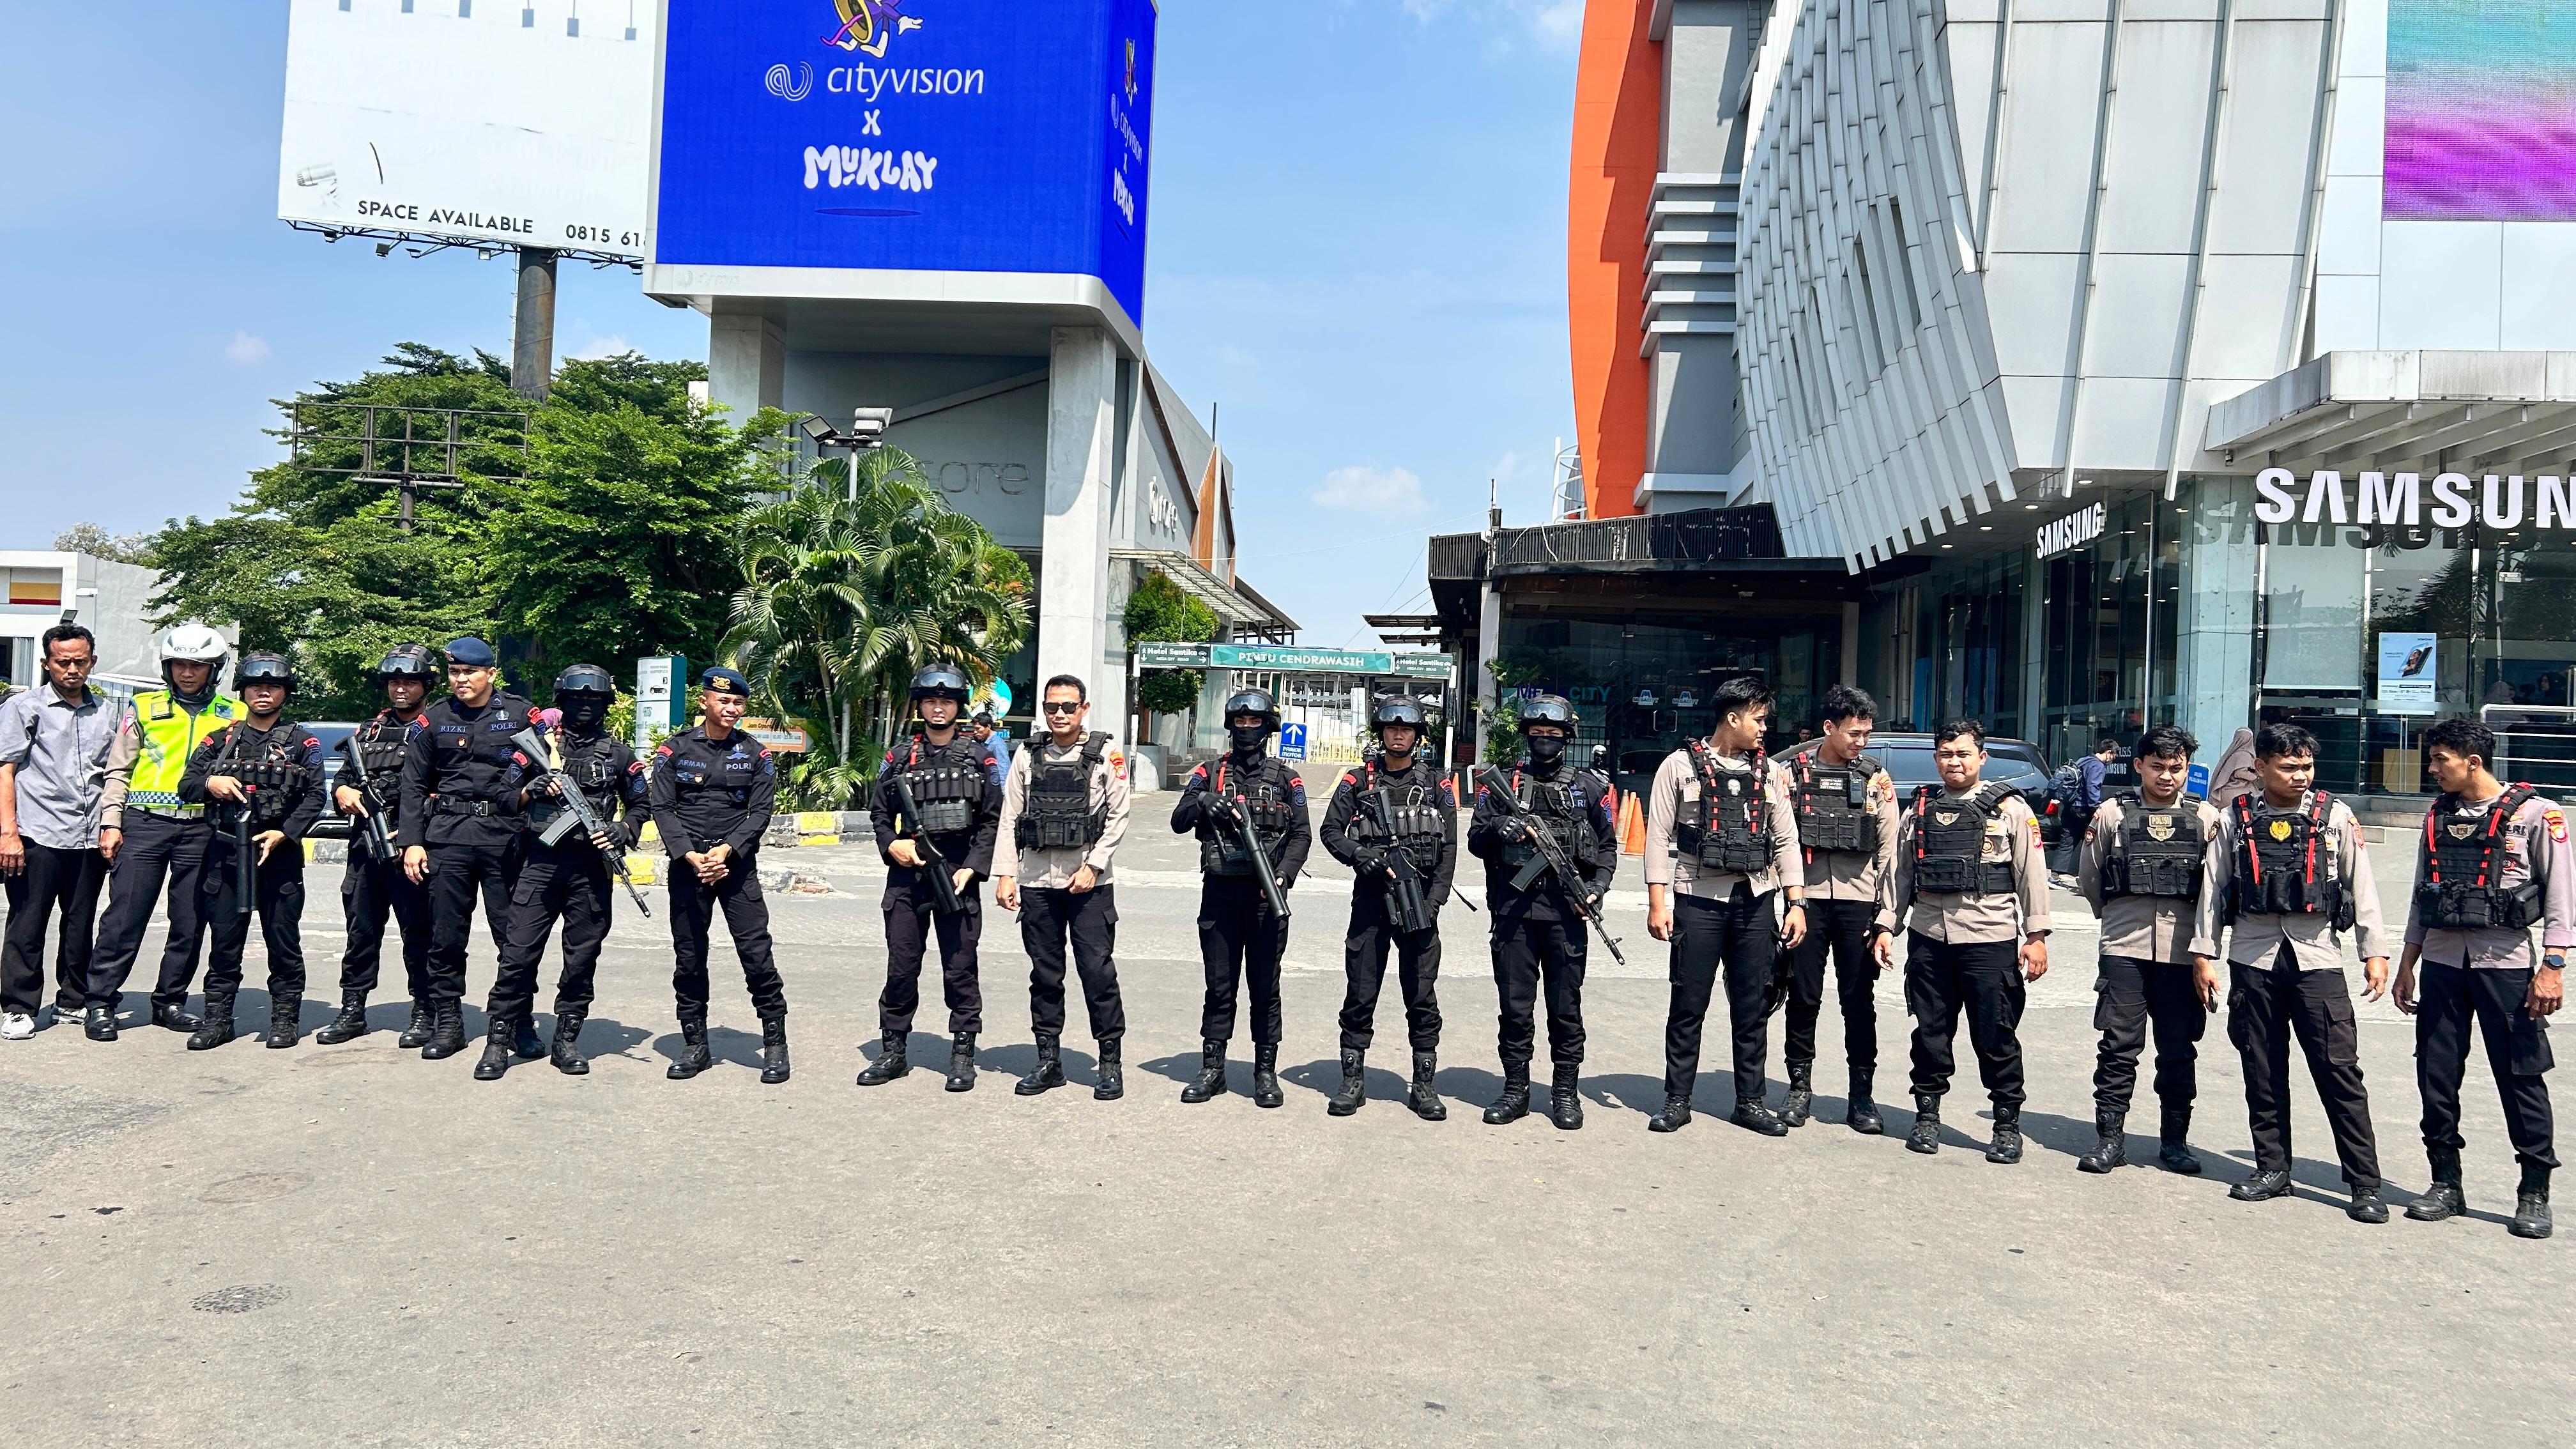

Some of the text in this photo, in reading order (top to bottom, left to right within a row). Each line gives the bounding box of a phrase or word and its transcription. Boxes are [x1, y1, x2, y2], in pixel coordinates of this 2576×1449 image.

[827, 61, 985, 102] cityvision
[357, 200, 645, 247] SPACE AVAILABLE 0815 61
[2036, 502, 2103, 560] SAMSUNG
[1147, 647, 1198, 656] Hotel Santika
[1279, 654, 1365, 666] CENDRAWASIH
[440, 725, 467, 733] RIZKI
[491, 721, 518, 732] POLRI
[677, 758, 707, 769] ARMAN
[726, 762, 751, 770] POLRI
[2106, 763, 2127, 774] AMSUNG
[2152, 816, 2170, 825] POLISI
